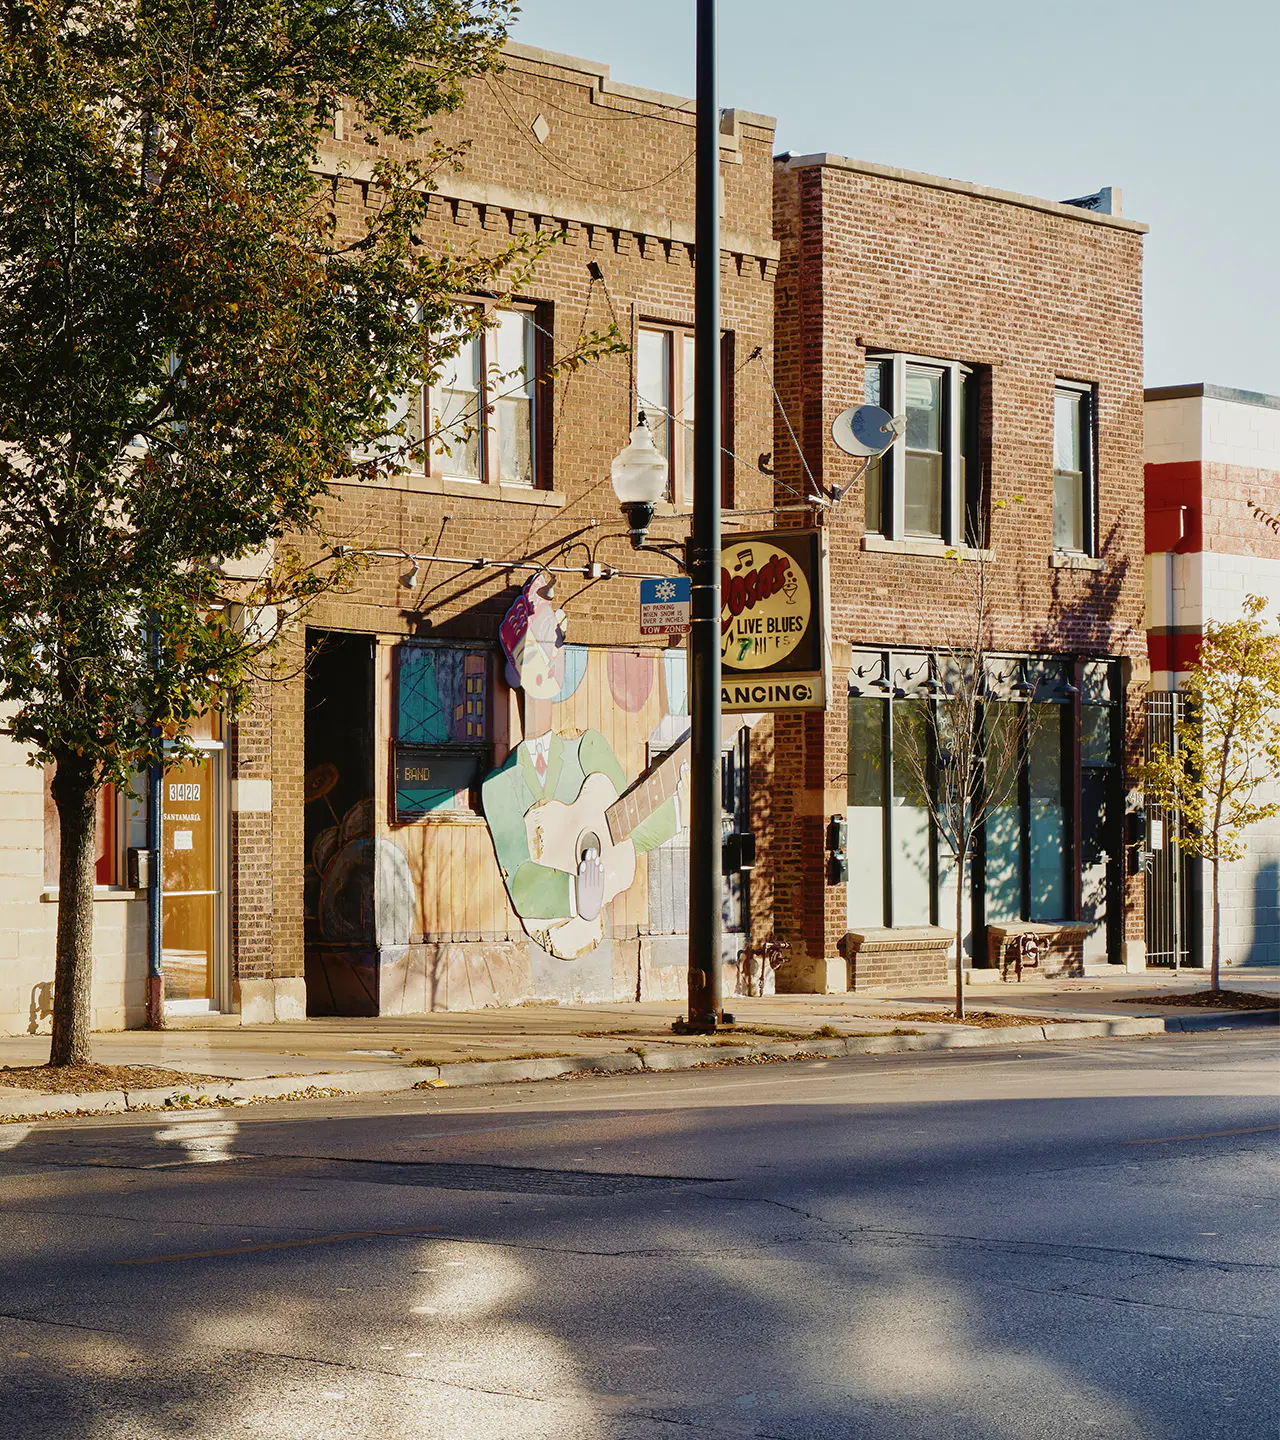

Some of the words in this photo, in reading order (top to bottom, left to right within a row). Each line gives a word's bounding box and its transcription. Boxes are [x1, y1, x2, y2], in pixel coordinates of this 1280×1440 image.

[643, 617, 657, 625] OVER
[737, 618, 763, 635] LIVE
[767, 615, 804, 633] BLUES
[643, 626, 661, 634] TOW
[664, 625, 686, 633] ZONE
[737, 637, 753, 661] 7
[721, 684, 808, 704] ANCING
[404, 767, 430, 780] BAND
[170, 784, 200, 800] 3422
